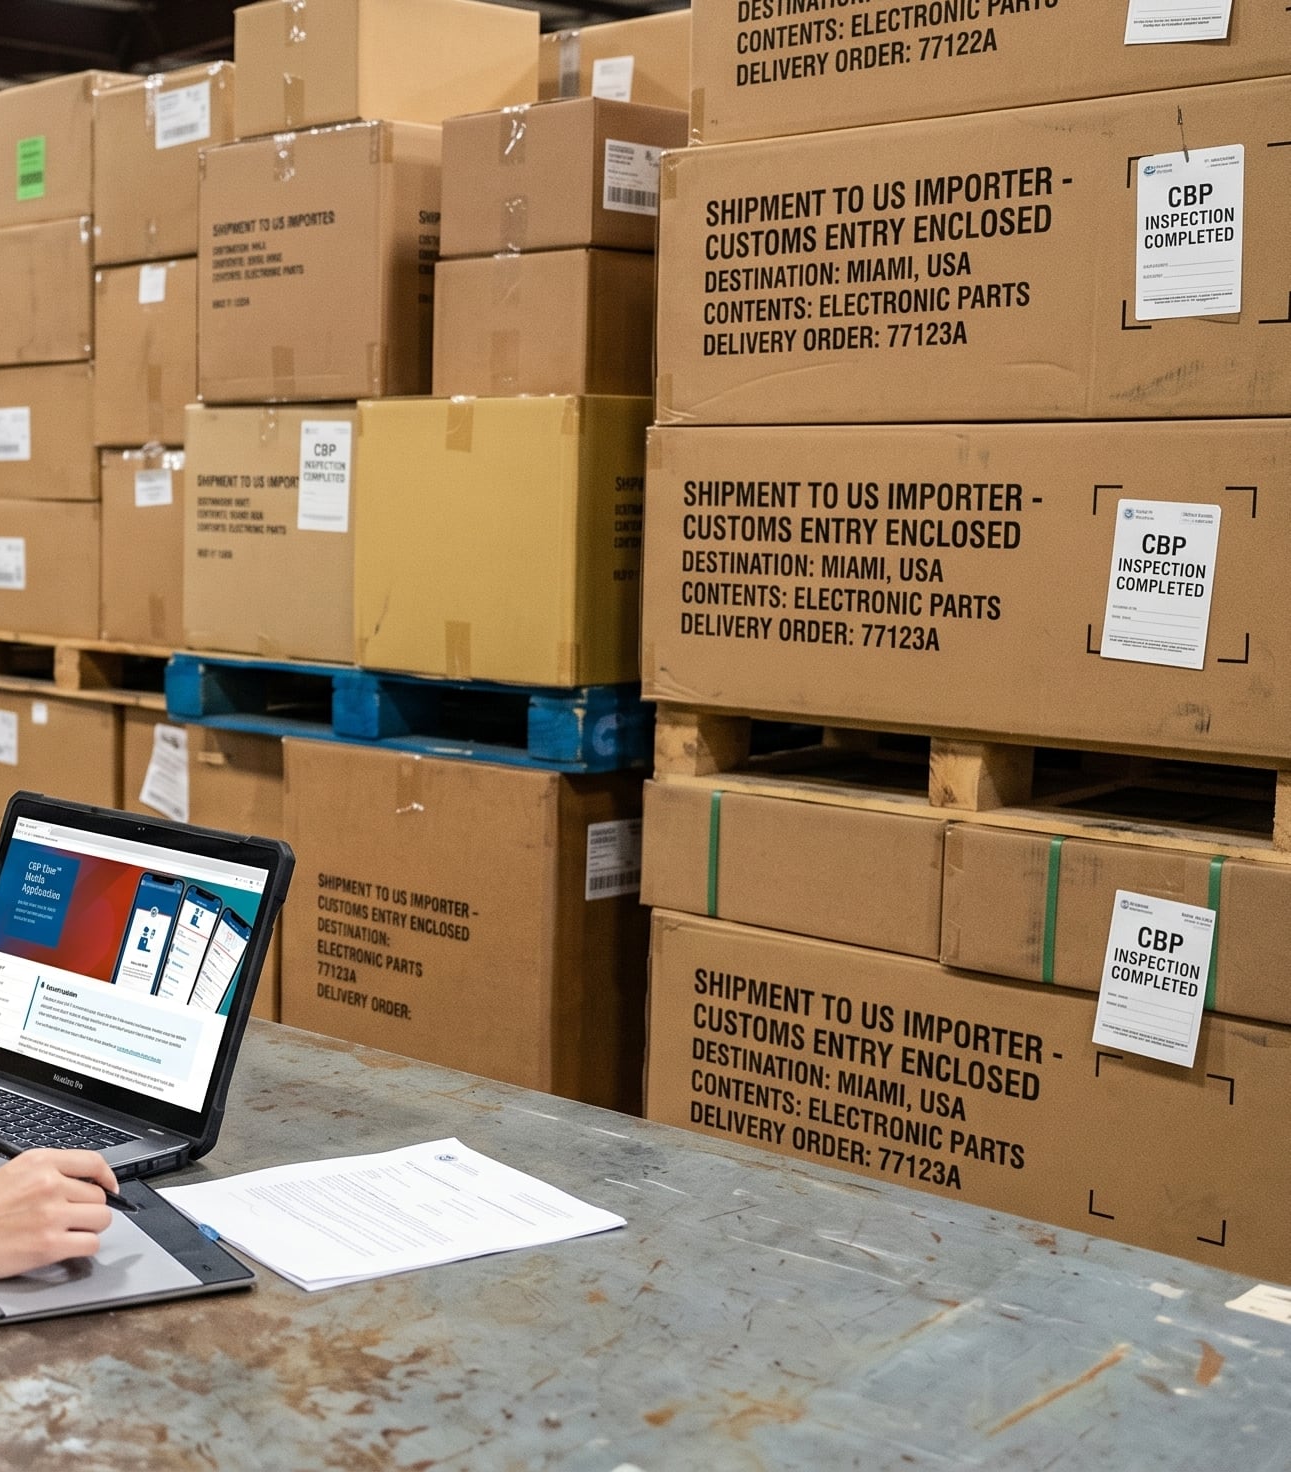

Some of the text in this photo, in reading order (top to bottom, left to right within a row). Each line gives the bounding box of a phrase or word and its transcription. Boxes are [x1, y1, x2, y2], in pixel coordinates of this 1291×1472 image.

[736, 17, 844, 55] CONTENTS:
[850, 0, 981, 38] ELECTRONIC
[736, 27, 998, 87] DELIVERY ORDER: 77122A
[705, 188, 827, 228] SHIPMENT
[832, 184, 864, 215] TO
[873, 180, 906, 212] US
[914, 166, 1053, 208] IMPORTER
[1168, 182, 1214, 208] CBP
[705, 204, 1052, 261] CUSTOMS ENTRY ENCLOSED
[1145, 206, 1235, 231] INSPECTION
[1144, 226, 1234, 250] COMPLETED
[704, 251, 972, 294] DESTINATION: MIAMI, USA
[703, 281, 1030, 325] CONTENTS: ELECTRONIC PARTS
[703, 320, 968, 357] DELIVERY ORDER: 77123A
[314, 443, 336, 456] CBP
[683, 480, 802, 509] SHIPMENT
[807, 481, 839, 510] TO
[847, 481, 879, 511] US
[887, 482, 1023, 512] IMPORTER
[683, 513, 1021, 550] CUSTOMS ENTRY ENCLOSED
[1141, 533, 1187, 557] CBP
[682, 549, 944, 585] DESTINATION: MIAMI, USA
[1118, 557, 1207, 579] INSPECTION
[681, 580, 1001, 621] CONTENTS: ELECTRONIC PARTS
[1116, 575, 1205, 598] COMPLETED
[680, 612, 940, 652] DELIVERY ORDER: 77123A
[318, 873, 372, 898] SHIPMENT
[375, 885, 389, 901] TO
[392, 889, 407, 905] US
[410, 892, 469, 919] IMPORTER
[318, 895, 470, 942] CUSTOMS ENTRY ENCLOSED
[318, 917, 390, 947] DESTINATION:
[317, 939, 423, 978] ELECTRONIC PARTS
[1138, 926, 1184, 954] CBP
[317, 961, 356, 983] 77123A
[1111, 965, 1198, 998] COMPLETED
[1114, 947, 1201, 980] INSPECTION
[317, 983, 412, 1020] DELIVERY ORDER:
[694, 967, 816, 1018] SHIPMENT
[821, 993, 852, 1025] TO
[861, 1001, 895, 1034] US
[903, 1010, 1045, 1065] IMPORTER
[693, 1002, 1041, 1102] CUSTOMS ENTRY ENCLOSED
[692, 1038, 966, 1122] DESTINATION: MIAMI, USA
[691, 1069, 1025, 1170] CONTENTS: ELECTRONIC PARTS
[690, 1101, 962, 1190] DELIVERY ORDER: 77123A
